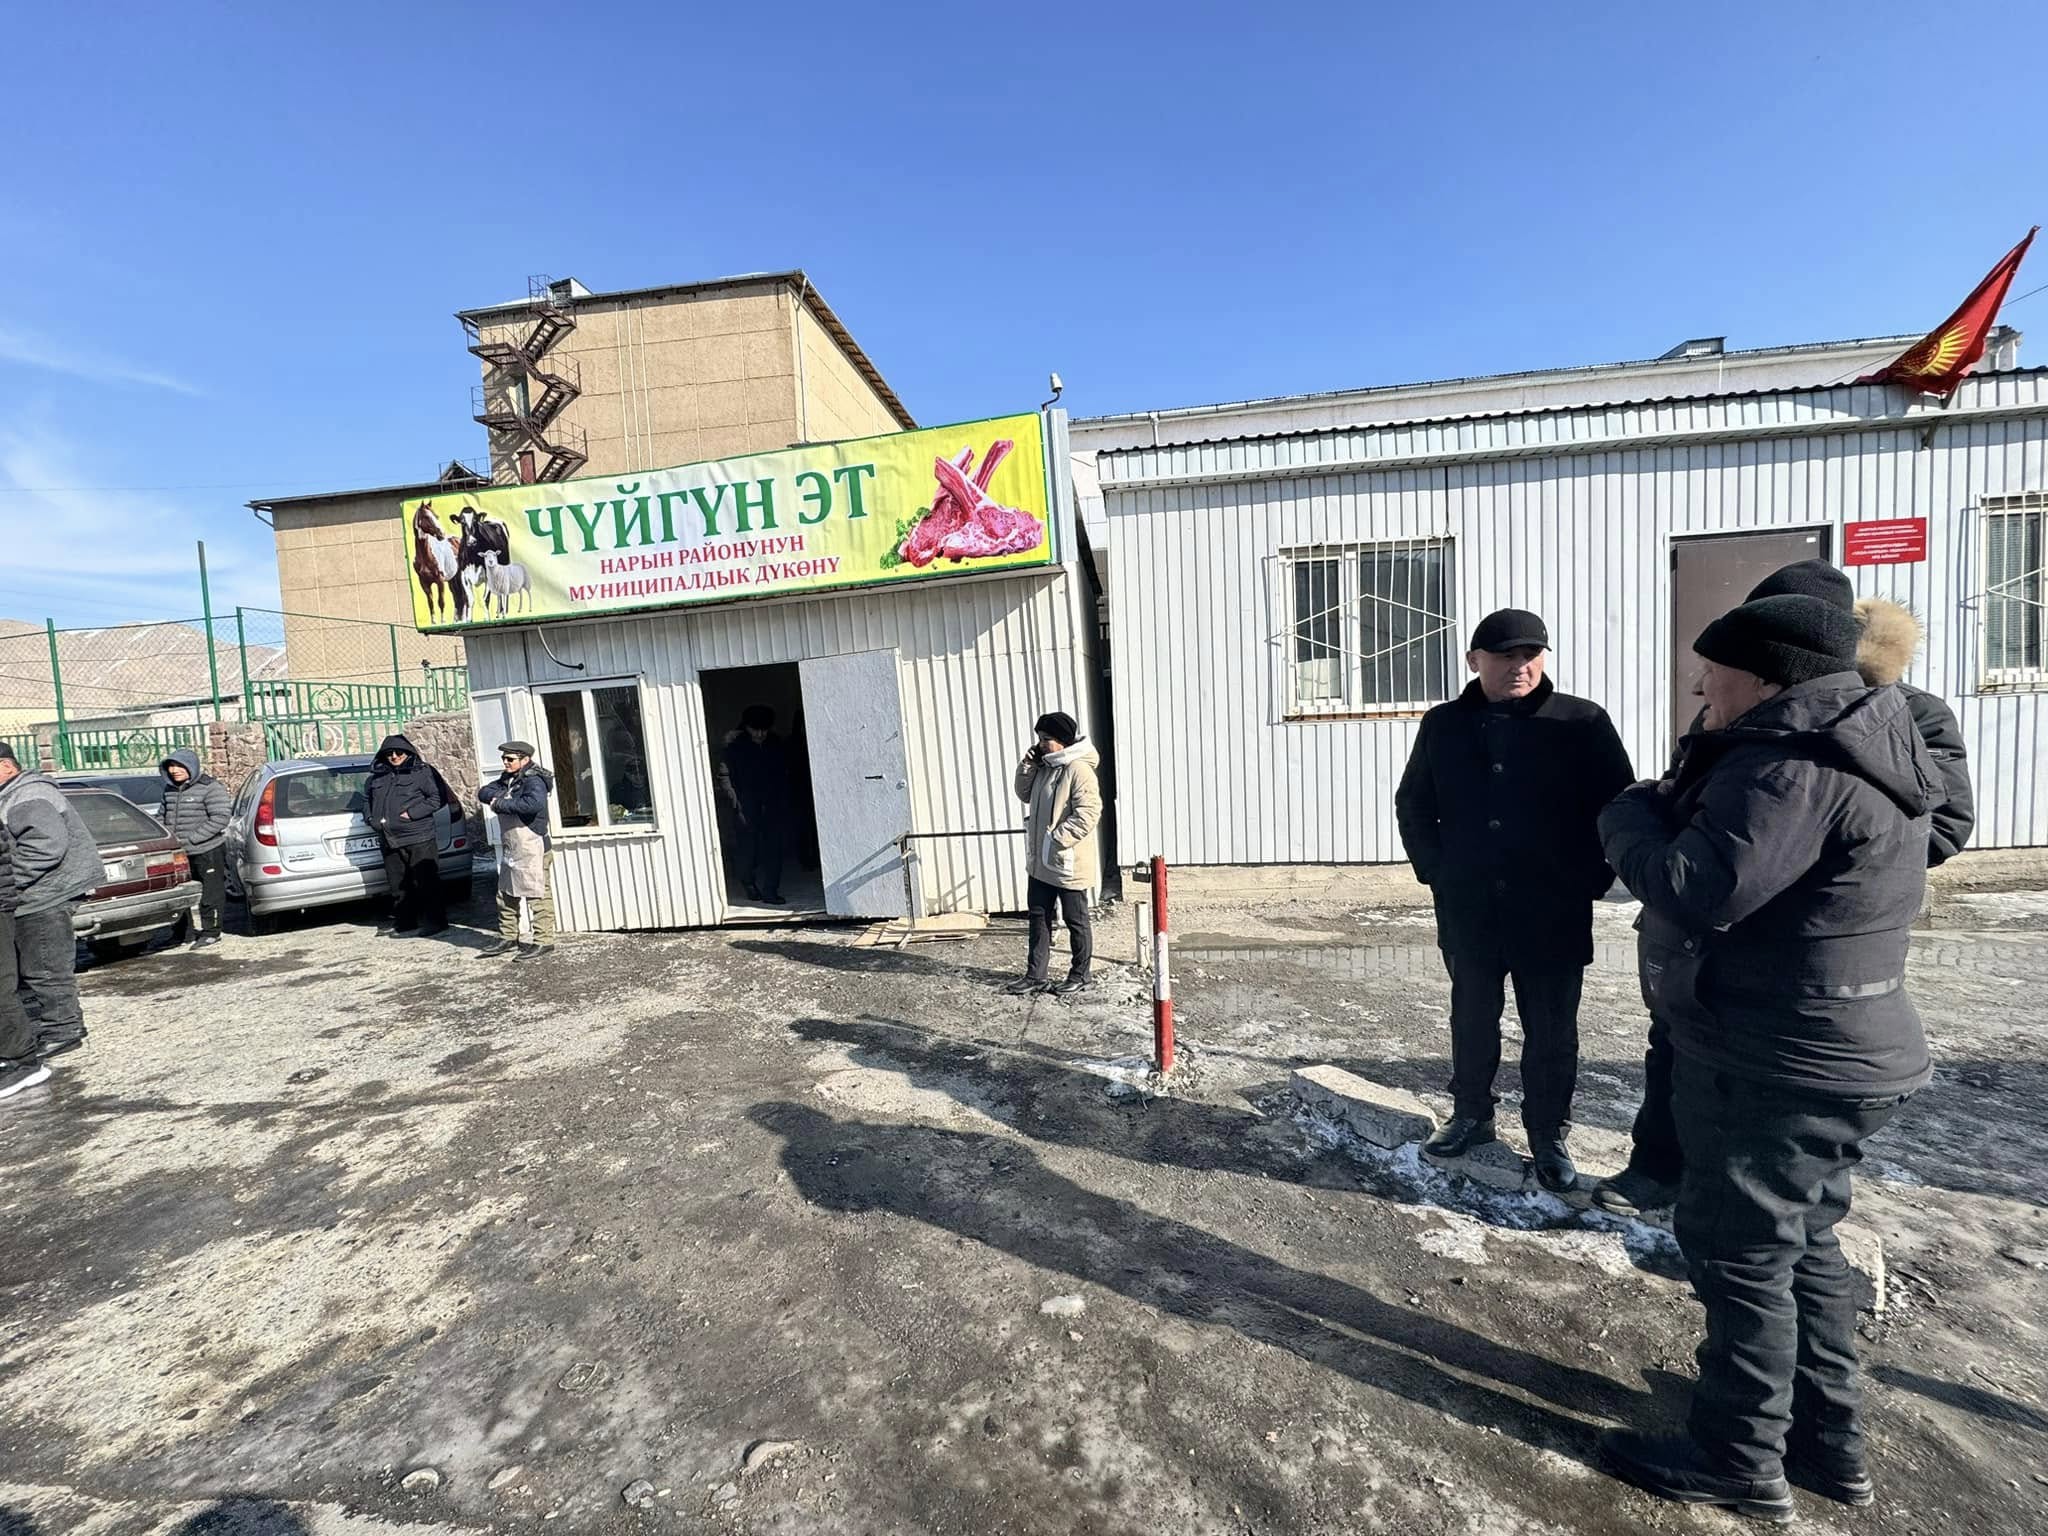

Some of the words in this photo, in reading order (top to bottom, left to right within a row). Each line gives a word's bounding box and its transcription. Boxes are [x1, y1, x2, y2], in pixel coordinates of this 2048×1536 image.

[525, 478, 779, 555] ЧҮЙГҮН
[796, 463, 875, 524] ЭТ
[600, 551, 674, 575] НАРЫН
[679, 535, 805, 566] РАЙОНУНУН
[569, 567, 750, 602] МУНИЦИПАЛДЫК
[755, 556, 841, 585] ДҮКӨНҮ
